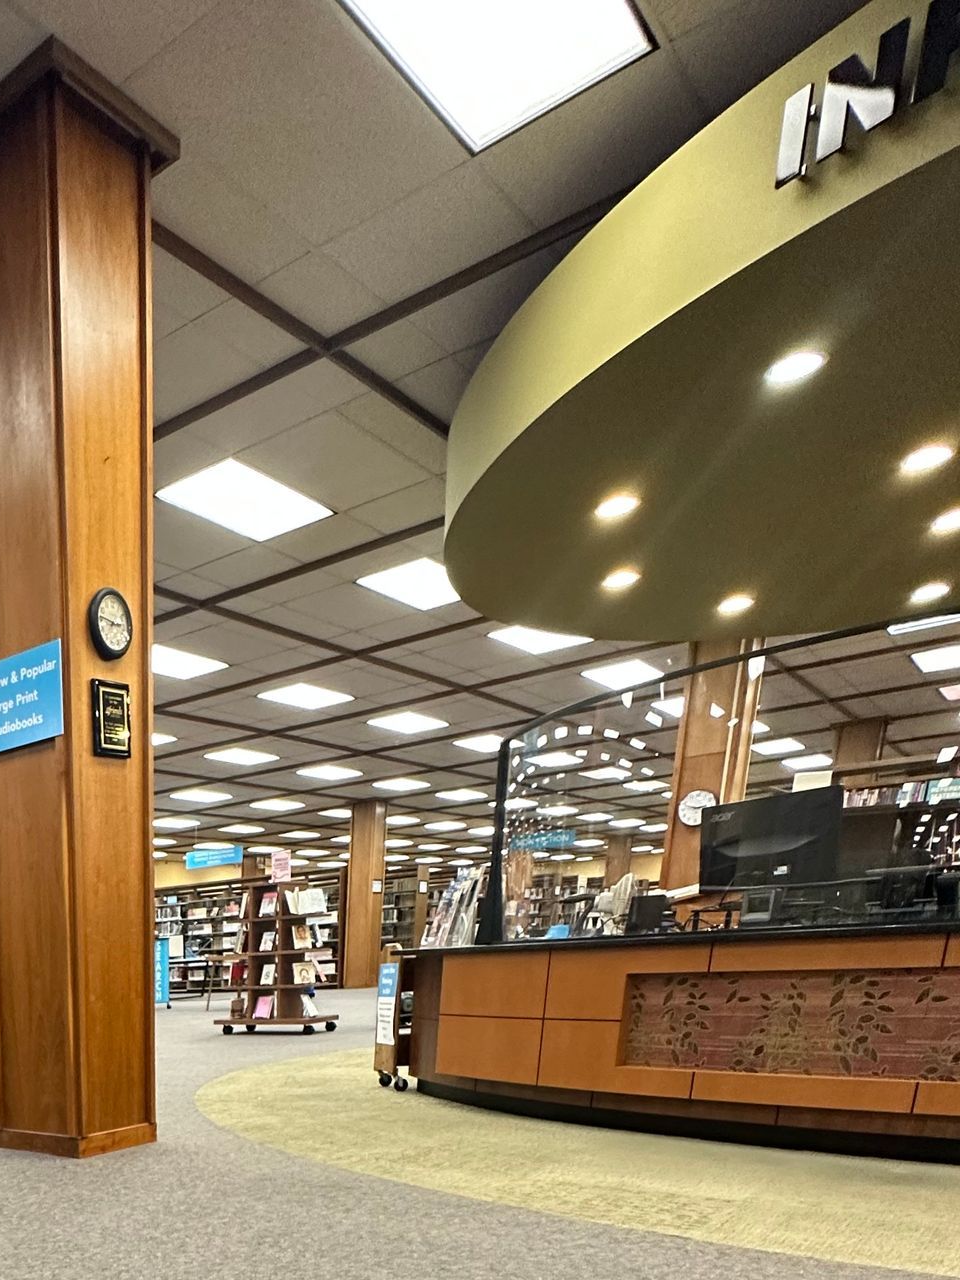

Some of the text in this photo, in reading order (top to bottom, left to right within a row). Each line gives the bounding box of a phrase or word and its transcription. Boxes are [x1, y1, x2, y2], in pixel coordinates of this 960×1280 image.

[10, 671, 18, 684] &
[20, 659, 57, 681] Popular
[16, 689, 38, 706] Print
